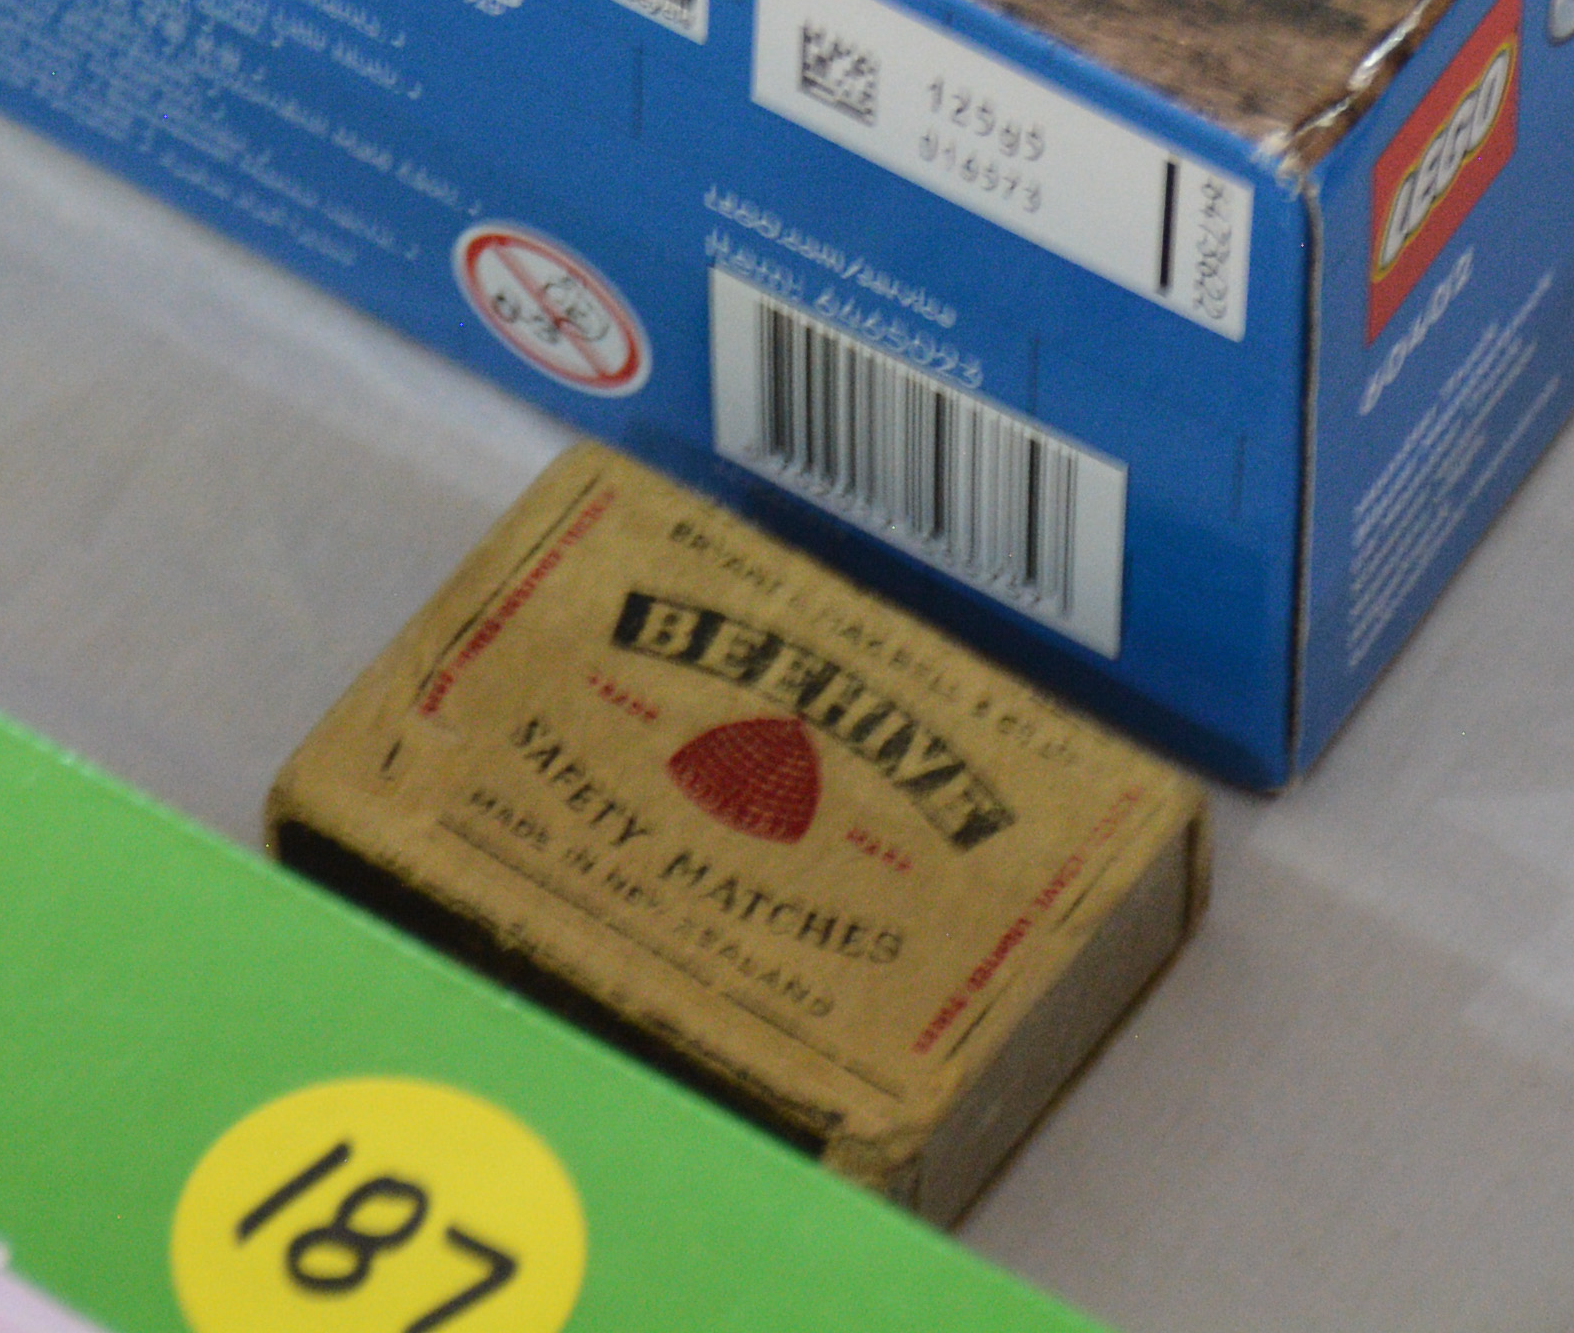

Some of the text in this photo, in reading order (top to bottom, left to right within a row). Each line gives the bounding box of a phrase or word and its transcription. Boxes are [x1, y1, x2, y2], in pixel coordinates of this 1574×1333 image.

[1379, 41, 1513, 275] LEGO
[632, 597, 1008, 847] BEEHIVE
[468, 789, 552, 852] MADE
[676, 918, 837, 1020] ZEALAND
[512, 717, 903, 965] SAFETY MATCHES
[234, 1138, 519, 1333] 187
